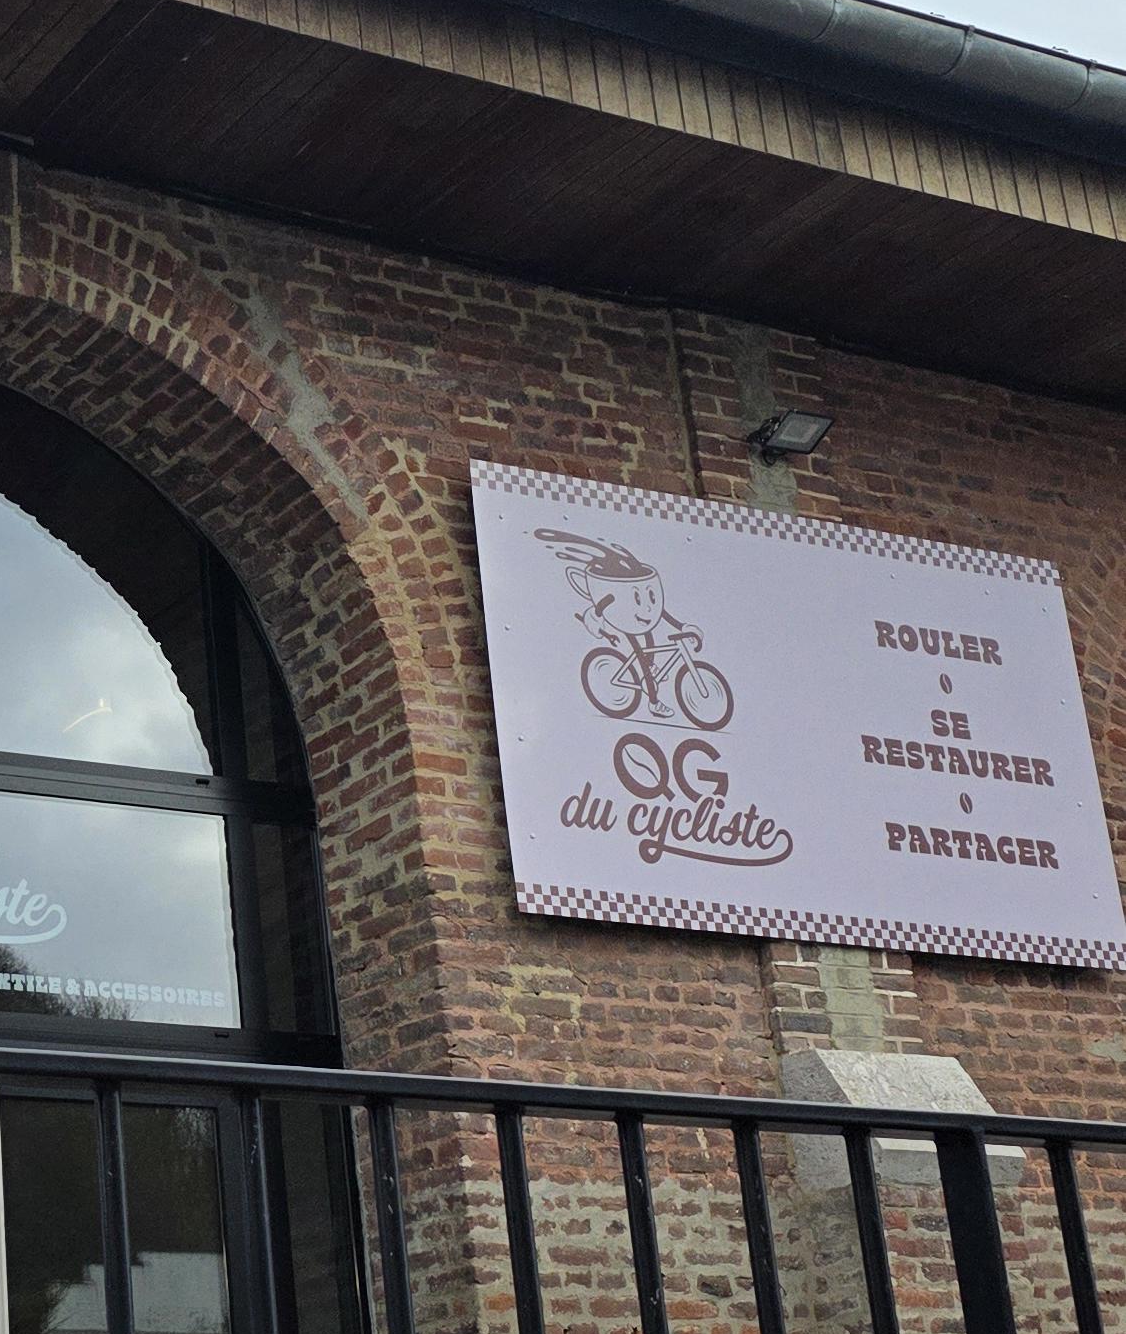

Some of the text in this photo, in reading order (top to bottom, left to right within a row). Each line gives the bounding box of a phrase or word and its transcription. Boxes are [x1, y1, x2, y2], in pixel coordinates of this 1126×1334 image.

[874, 620, 1002, 666] ROULER
[930, 709, 971, 740] SE
[613, 733, 729, 803] QG
[861, 734, 1055, 787] RESTAURER
[560, 781, 793, 867] du cycliste
[885, 822, 1060, 869] PARTAGER
[65, 978, 80, 995] &
[83, 980, 225, 1008] ACCESSOIRES
